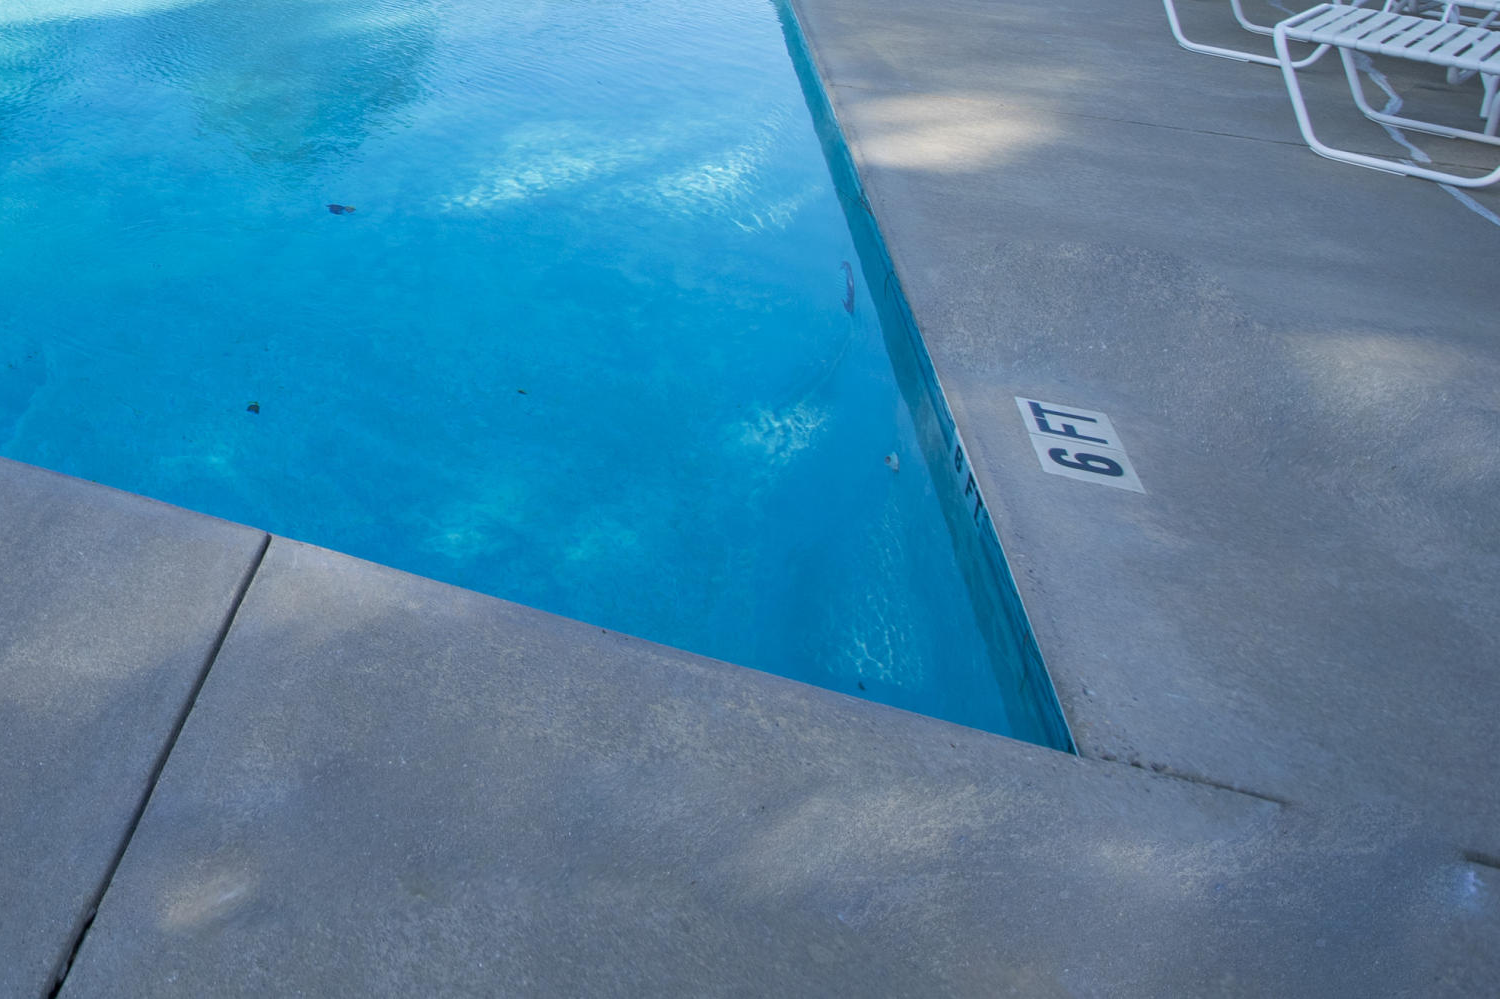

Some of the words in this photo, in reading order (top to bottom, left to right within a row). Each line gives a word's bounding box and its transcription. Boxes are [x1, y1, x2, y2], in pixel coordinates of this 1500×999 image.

[1027, 400, 1109, 446] FT
[1047, 447, 1125, 478] 6
[965, 471, 984, 520] FT
